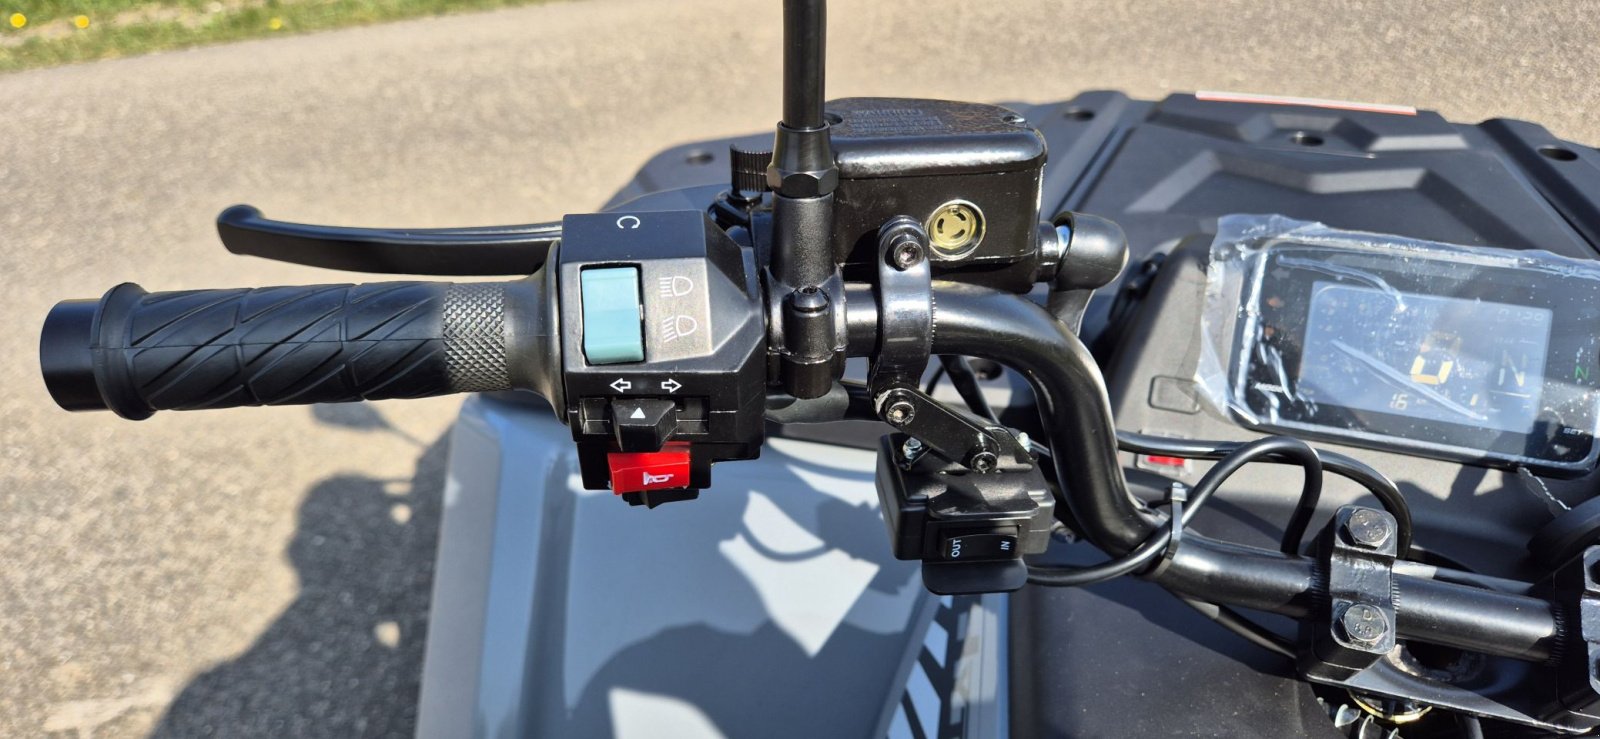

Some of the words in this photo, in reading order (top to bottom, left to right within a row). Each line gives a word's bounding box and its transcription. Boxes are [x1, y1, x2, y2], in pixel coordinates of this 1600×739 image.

[1498, 349, 1527, 387] N
[1575, 365, 1589, 380] N
[951, 539, 962, 558] OUT
[1000, 540, 1010, 550] IN
